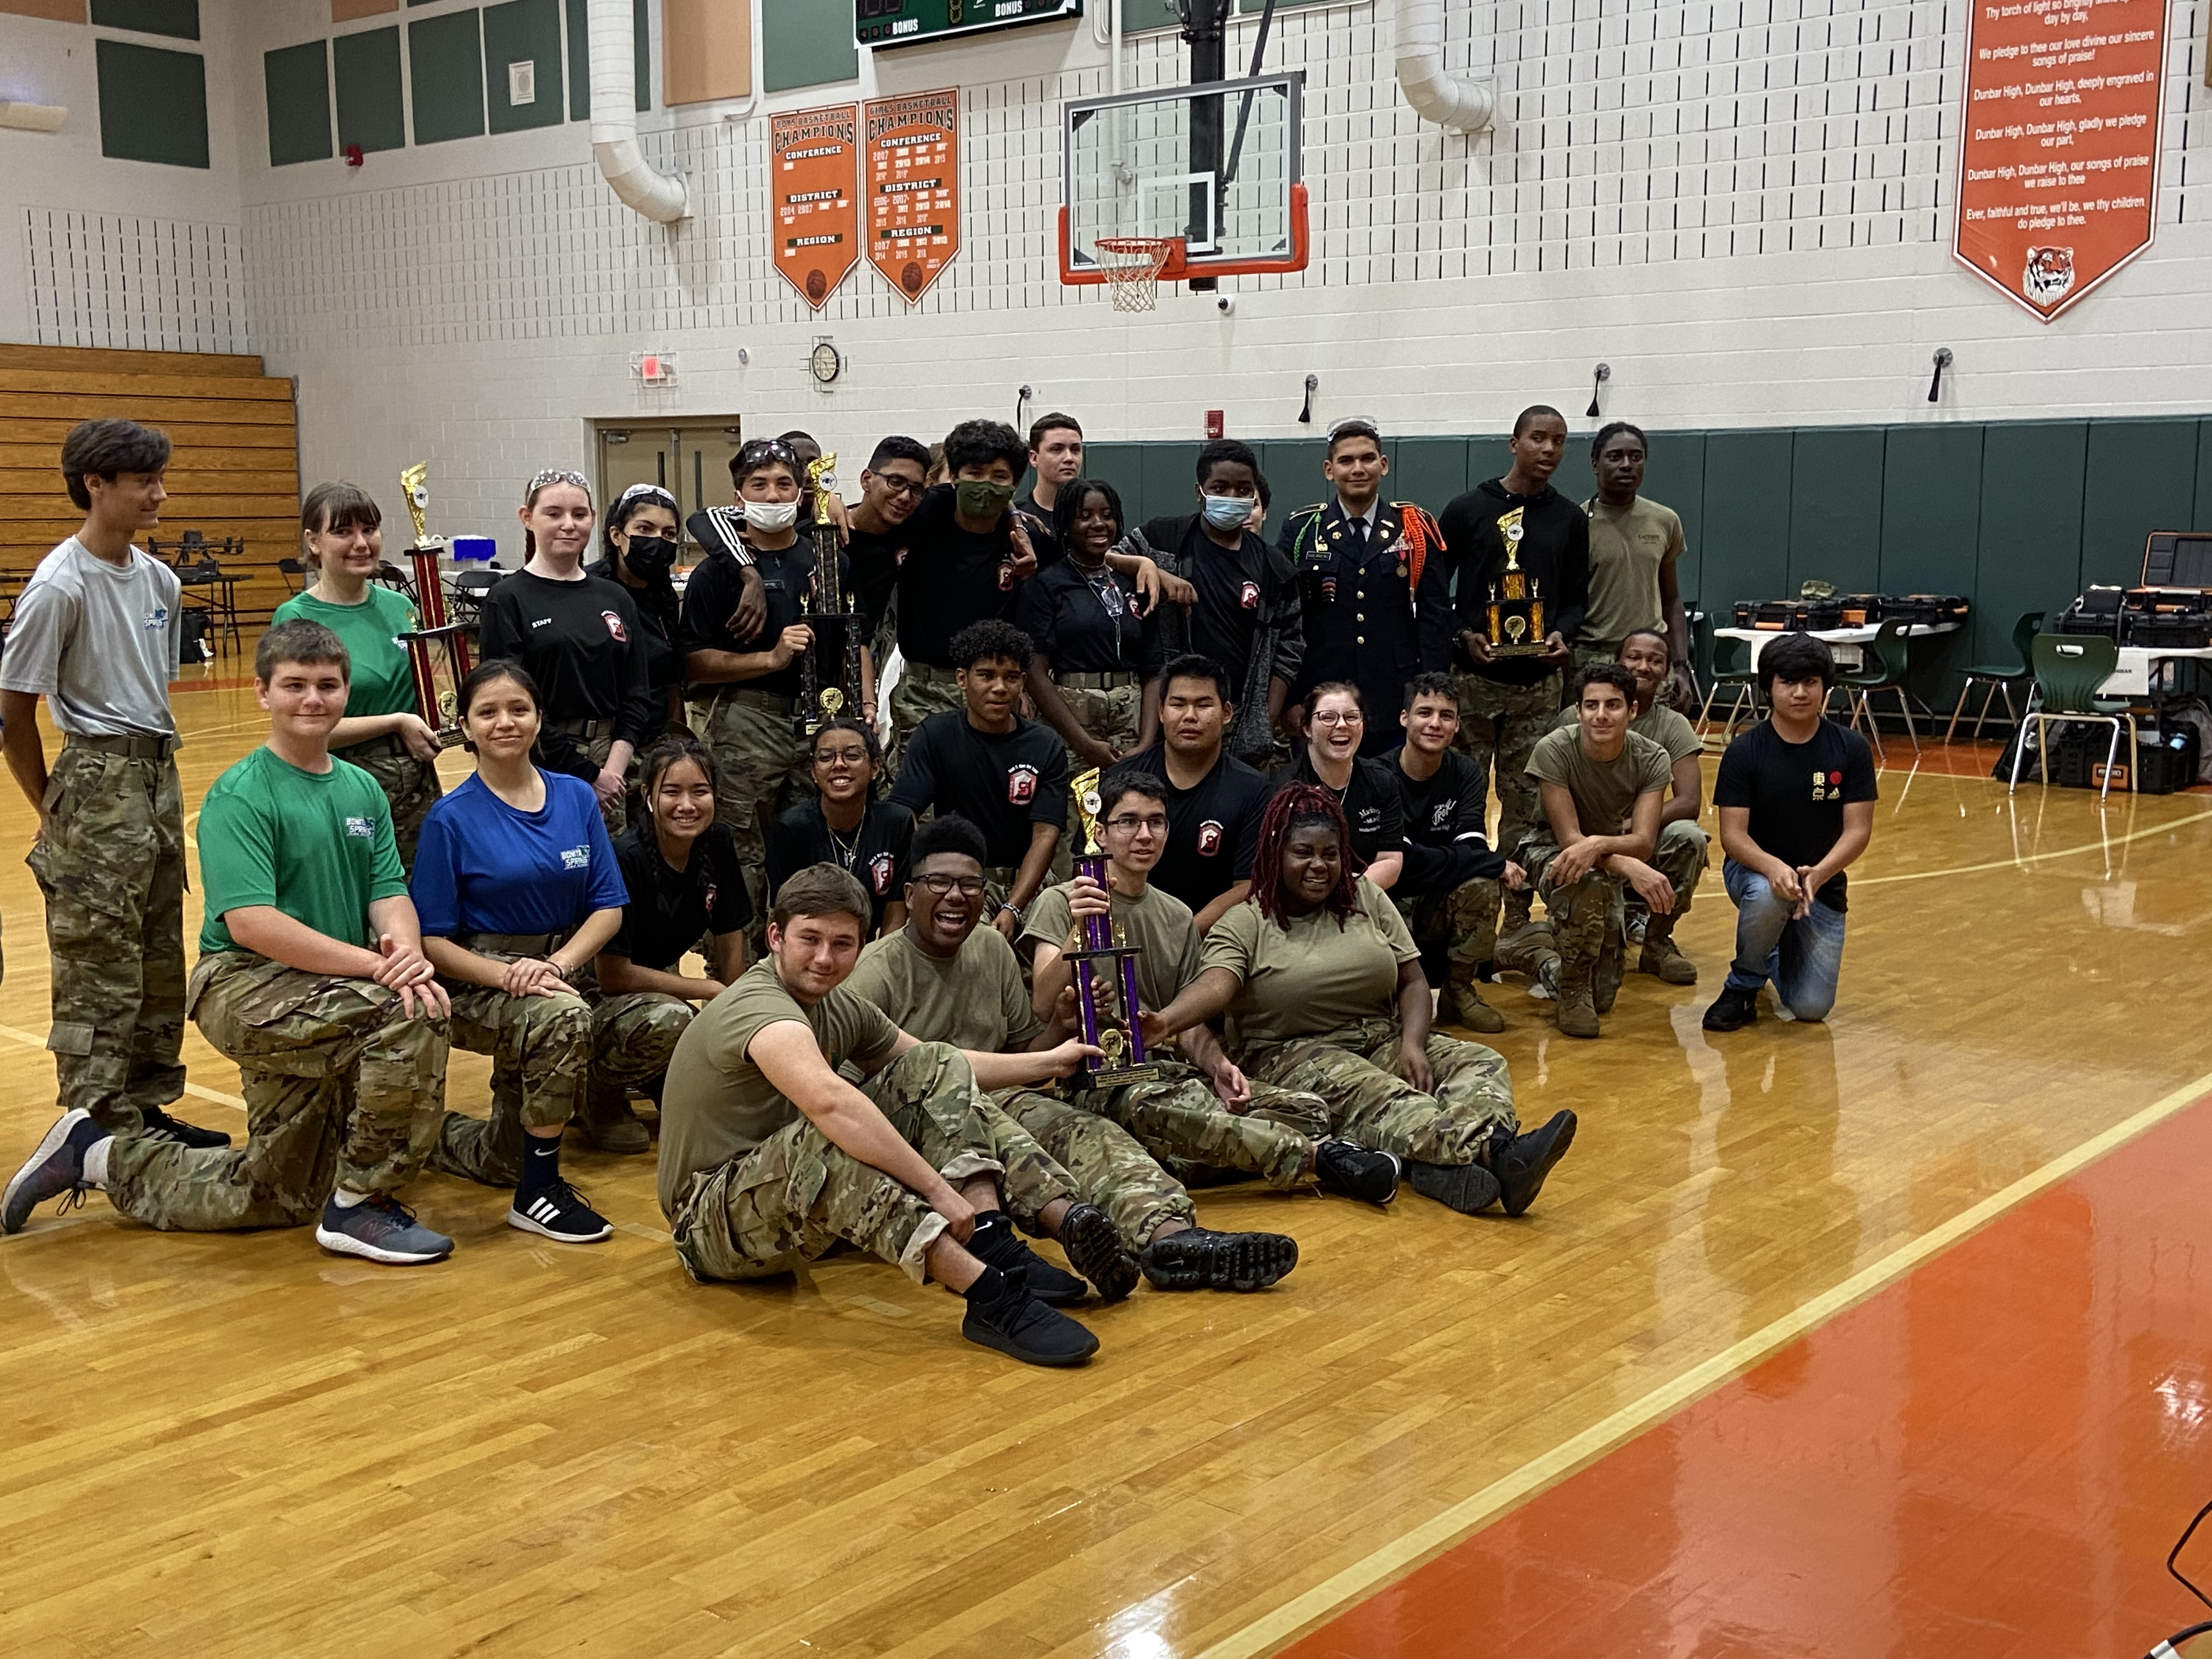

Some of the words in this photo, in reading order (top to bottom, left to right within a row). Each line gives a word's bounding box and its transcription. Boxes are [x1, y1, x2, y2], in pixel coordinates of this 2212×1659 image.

[995, 1, 1023, 17] BONUS
[1985, 7, 2000, 21] Thy
[2001, 4, 2022, 17] torch
[2023, 2, 2033, 14] of
[2033, 1, 2051, 15] light
[2052, 1, 2063, 10] so
[893, 19, 918, 35] BONUS
[2044, 13, 2059, 26] day
[2061, 12, 2071, 25] by
[1979, 48, 1991, 60] We
[1992, 46, 2019, 61] pledge
[2021, 44, 2029, 55] to
[2030, 42, 2047, 53] thee
[2049, 41, 2063, 52] our
[2064, 38, 2081, 50] love
[2082, 35, 2107, 48] divine
[2108, 33, 2123, 44] our
[2124, 31, 2155, 43] sincere
[2032, 55, 2057, 69] songs
[2058, 52, 2067, 64] of
[2068, 48, 2096, 66] praise!
[1974, 88, 2002, 101] Dunbar
[2003, 84, 2023, 99] High,
[2025, 82, 2054, 95] Dunbar
[2056, 80, 2076, 93] High,
[2077, 75, 2105, 91] deeply
[2106, 71, 2145, 88] engraved
[2146, 70, 2154, 82] in
[870, 104, 894, 115] GIRLS
[896, 96, 952, 112] BASKETBALL
[2039, 97, 2053, 107] our
[775, 117, 796, 128] BOYS
[797, 110, 851, 126] BASKETBALL
[868, 107, 954, 143] CHAMPIONS
[1976, 127, 2004, 140] Dunbar
[2005, 125, 2025, 140] High,
[2027, 122, 2056, 135] Dunbar
[2057, 119, 2077, 134] High,
[2079, 116, 2104, 133] gladly
[2105, 117, 2118, 127] we
[2118, 113, 2147, 129] pledge
[774, 122, 854, 155] CHAMPIONS
[881, 133, 941, 148] CONFERENCE
[2041, 137, 2055, 148] our
[785, 146, 843, 160] CONFERENCE
[873, 150, 889, 162] 2007
[1968, 168, 1996, 181] Dunbar
[1997, 165, 2017, 180] High,
[2018, 163, 2047, 176] Dunbar
[2070, 161, 2085, 172] our
[2086, 159, 2112, 172] songs
[2113, 155, 2123, 168] of
[2124, 154, 2149, 170] praise
[884, 179, 937, 193] DISTRICT
[2024, 178, 2036, 188] we
[2037, 176, 2057, 188] raise
[2058, 174, 2066, 186] to
[2068, 173, 2086, 185] thee
[790, 190, 838, 203] DISTRICT
[935, 200, 952, 210] 2014
[1966, 208, 1985, 221] Ever,
[1987, 205, 2014, 219] faithful
[2015, 204, 2029, 217] and
[2030, 204, 2048, 216] true,
[2050, 201, 2067, 213] we'll
[2083, 201, 2095, 211] we
[2096, 198, 2110, 213] thy
[2111, 195, 2145, 210] children
[2017, 218, 2028, 229] do
[2029, 216, 2056, 231] pledge
[2057, 215, 2066, 227] to
[2067, 213, 2087, 226] thee.
[890, 226, 933, 238] REGION
[796, 235, 836, 246] REGION
[874, 240, 890, 251] 2007
[532, 618, 552, 629] STAFF
[1812, 771, 1825, 801] 東京
